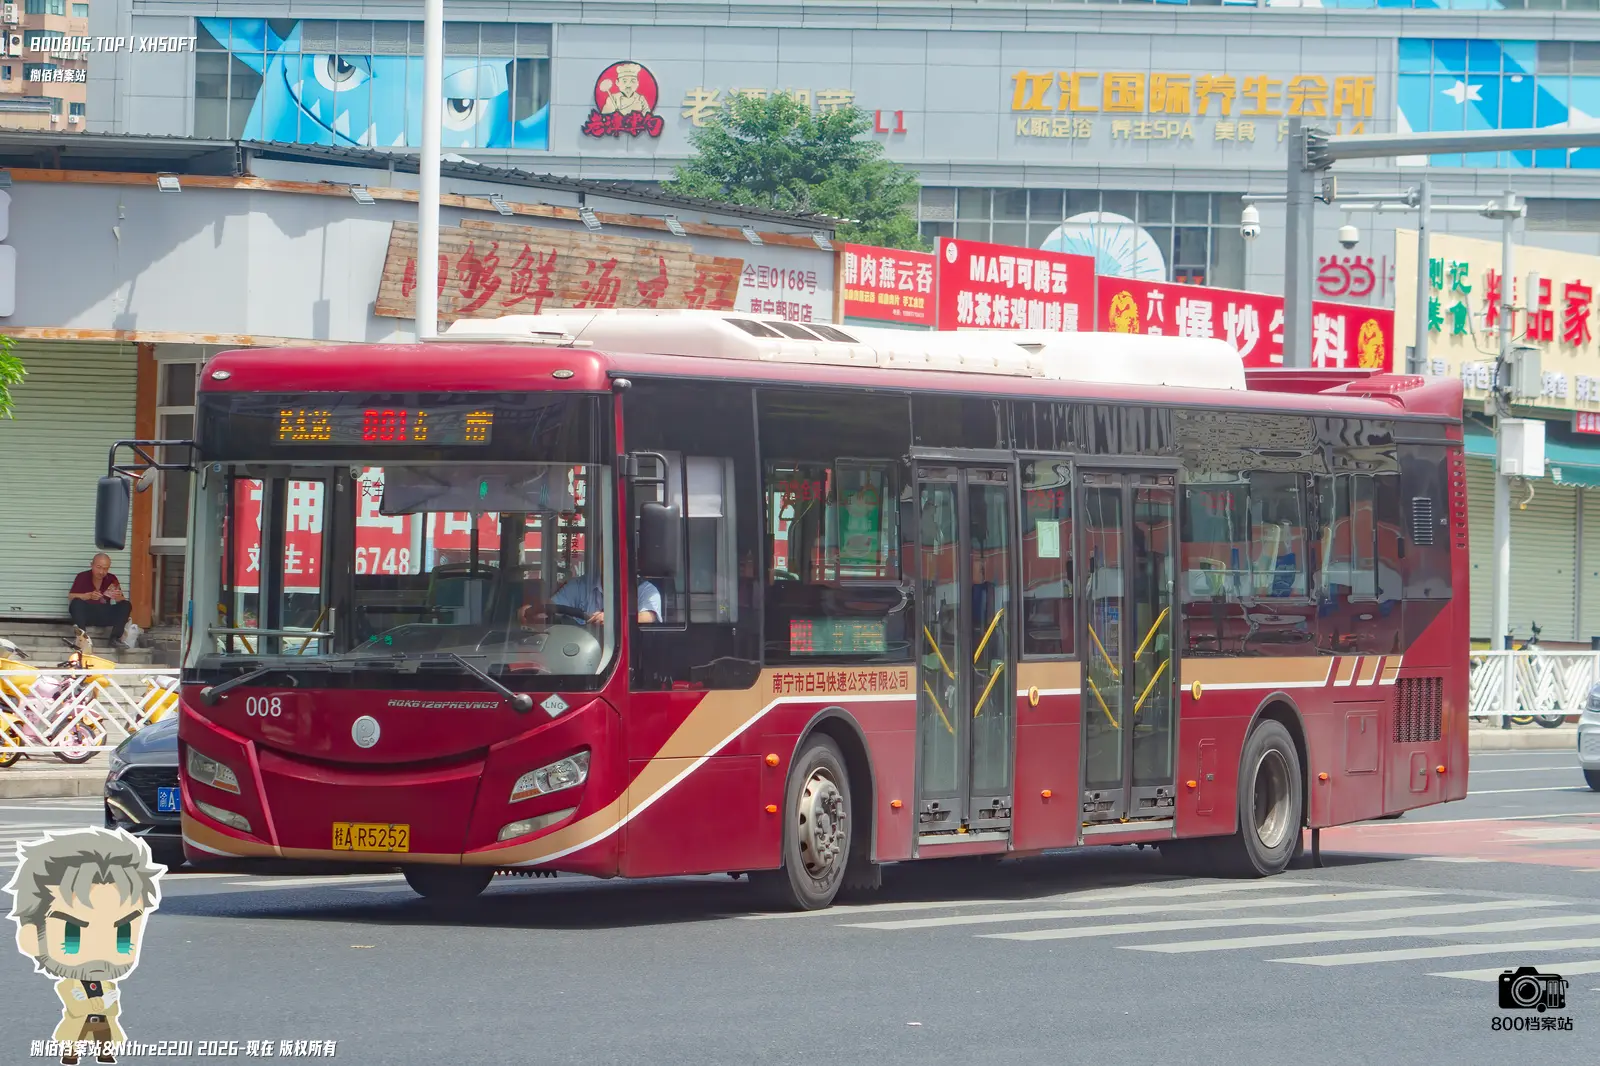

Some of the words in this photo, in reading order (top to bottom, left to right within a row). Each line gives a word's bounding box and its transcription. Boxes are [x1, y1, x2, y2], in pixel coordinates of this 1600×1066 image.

[1011, 69, 1376, 117] 龙汇国际养生会所
[1015, 117, 1093, 139] K歌足浴
[1111, 119, 1195, 140] 养生SPA
[1215, 120, 1256, 142] 美食
[743, 263, 818, 295] 全国0168号
[772, 670, 909, 694] 南宁市白马快速公交有限公司
[246, 696, 282, 717] 008
[545, 701, 564, 710] LNG
